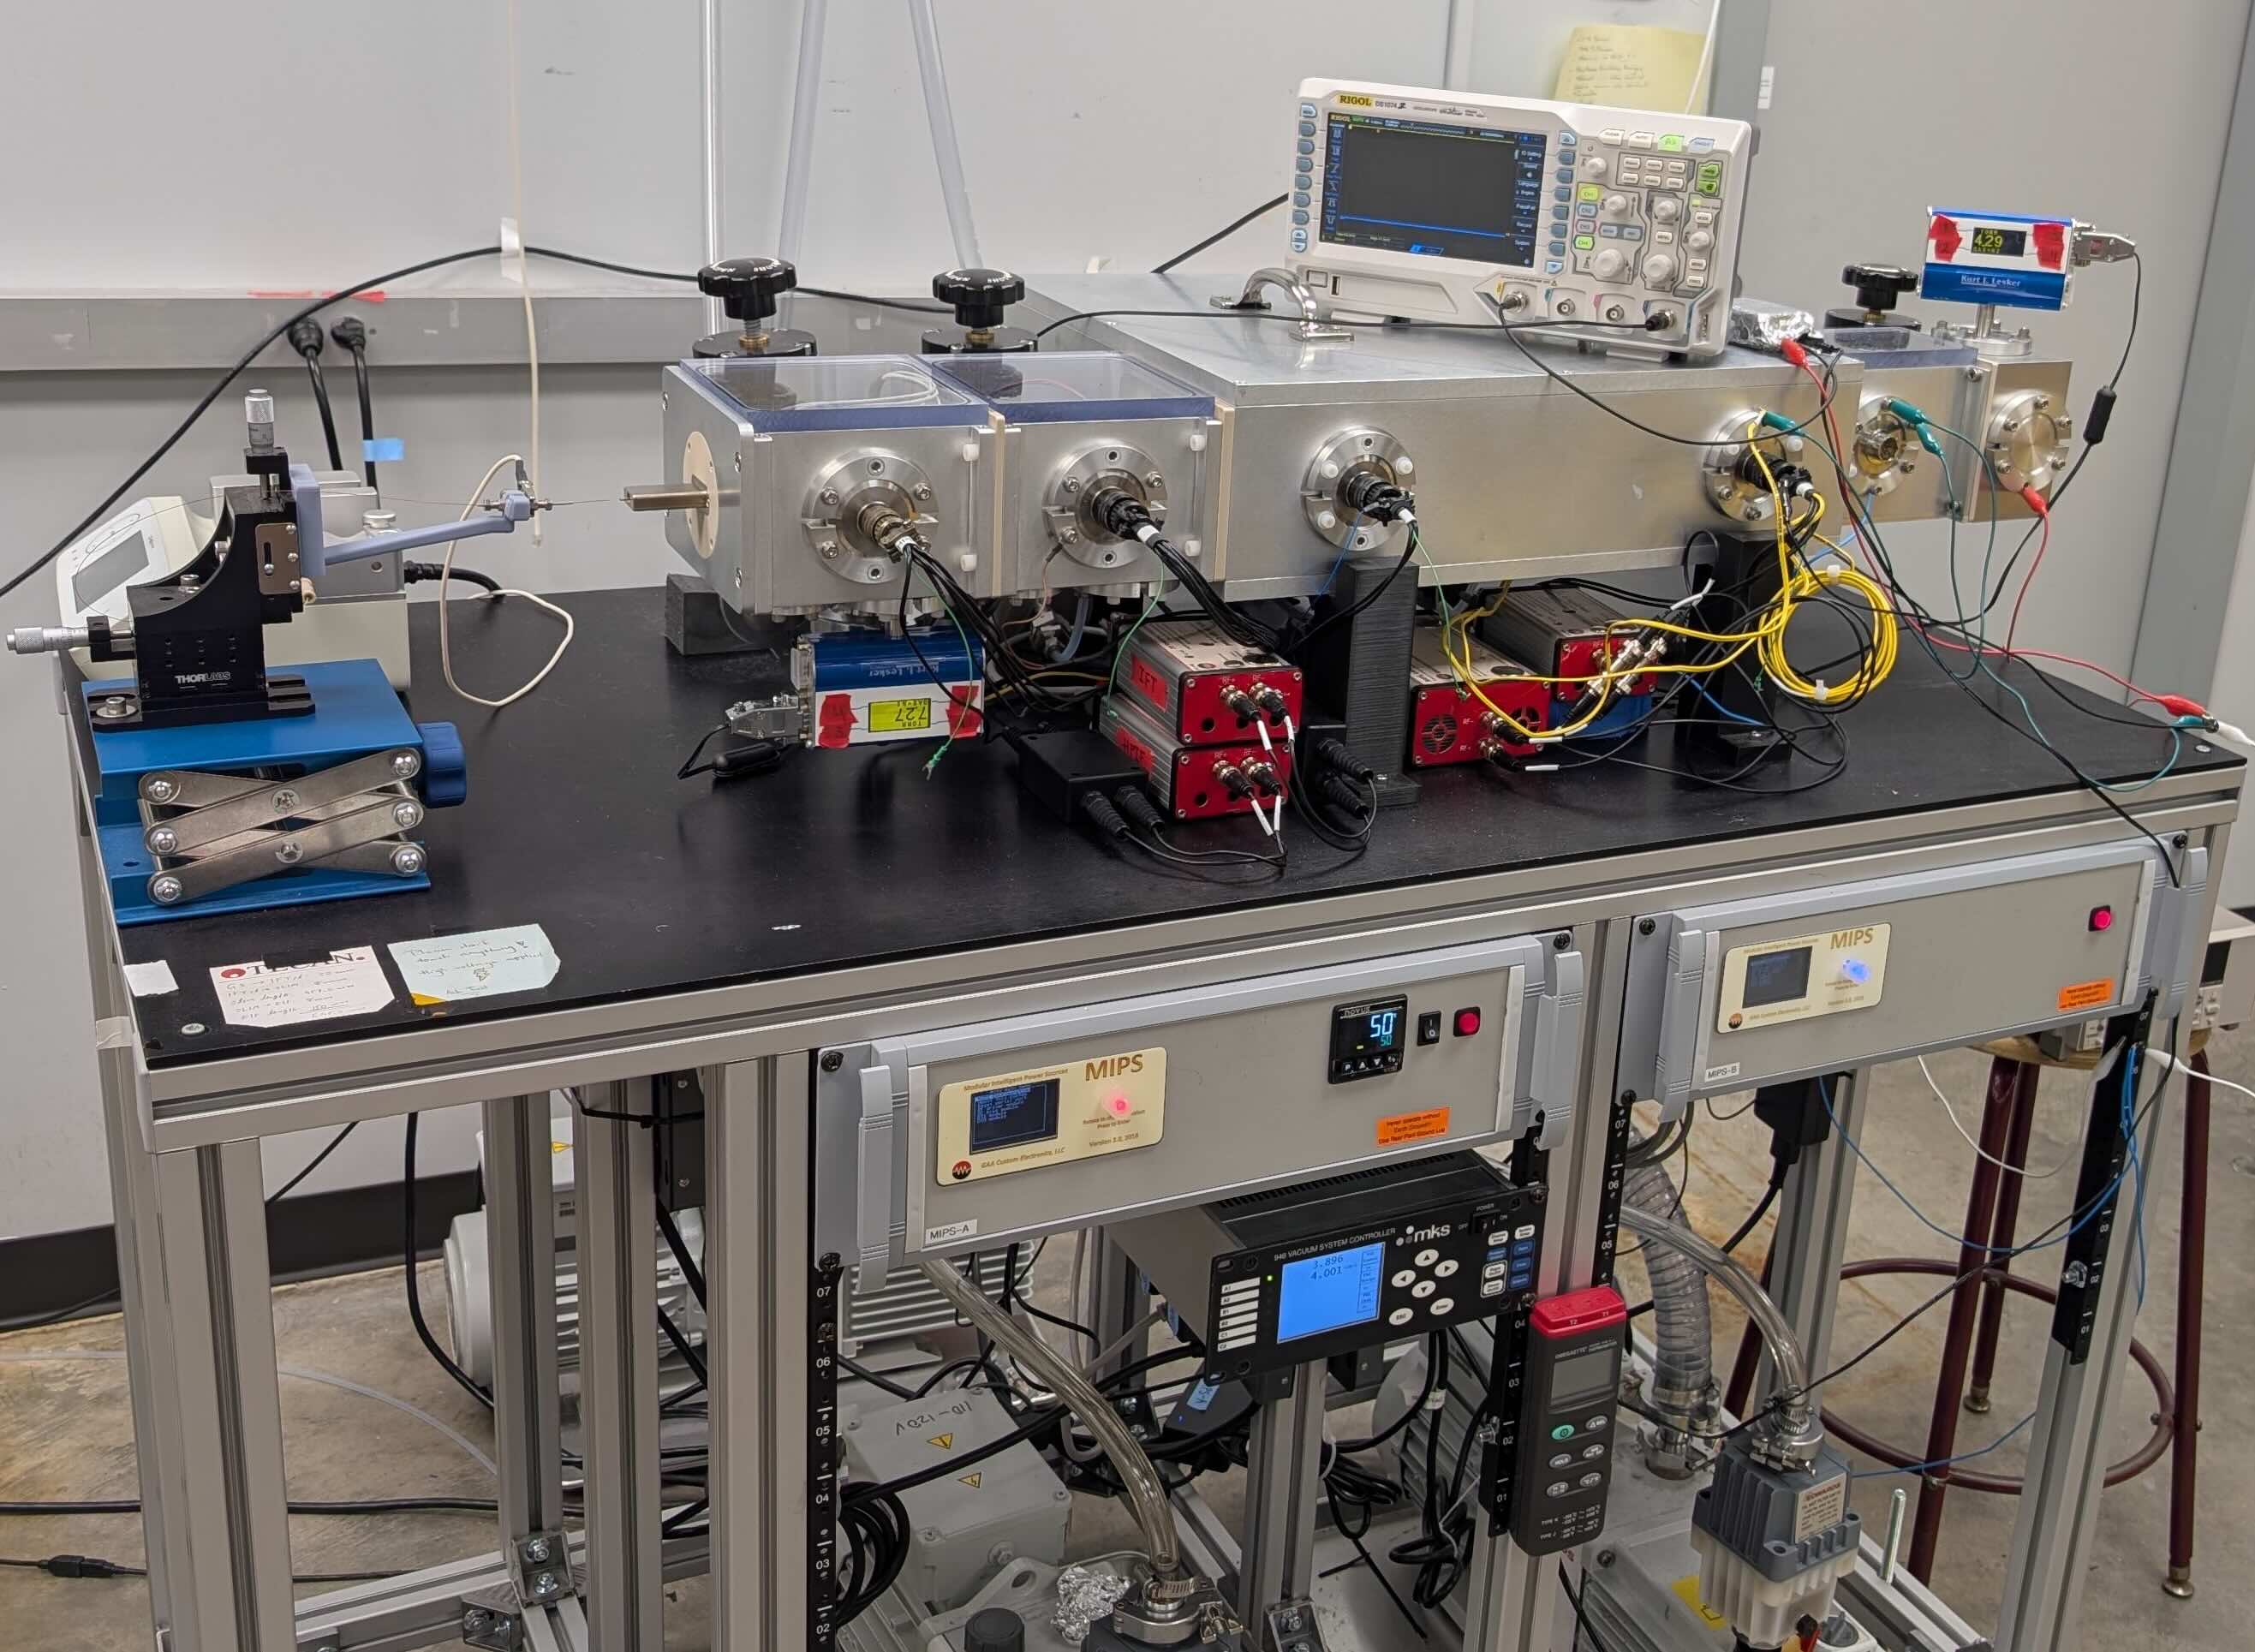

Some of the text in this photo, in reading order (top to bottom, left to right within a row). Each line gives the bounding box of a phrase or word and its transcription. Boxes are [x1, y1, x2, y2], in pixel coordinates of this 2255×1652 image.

[1339, 95, 1371, 106] RIGOL
[1974, 234, 2002, 248] 4.29
[1992, 278, 2021, 287] Lesker
[869, 666, 903, 677] Lesker
[917, 664, 939, 673] Krt
[1830, 927, 1874, 950] MIPS
[1370, 1012, 1393, 1038] 50
[1085, 1053, 1144, 1082] MIPS
[1614, 1118, 1626, 1129] 07
[1608, 1180, 1619, 1190] 06
[1414, 1224, 1451, 1243] mks
[1288, 1244, 1319, 1258] VACUUM
[1320, 1238, 1348, 1252] SYSTEM
[1349, 1227, 1396, 1244] CONTROLLER
[1602, 1241, 1613, 1250] 05
[1313, 1254, 1344, 1269] 3.896
[1310, 1266, 1342, 1281] 4.001
[816, 1286, 832, 1298] 07
[1515, 1320, 1526, 1329] 04
[816, 1357, 831, 1369] 06
[1508, 1378, 1520, 1388] 03
[815, 1425, 831, 1437] 05
[1502, 1436, 1514, 1446] 02
[815, 1494, 829, 1505] 04
[1496, 1494, 1507, 1503] 01
[816, 1559, 830, 1570] 03
[816, 1623, 830, 1634] 02
